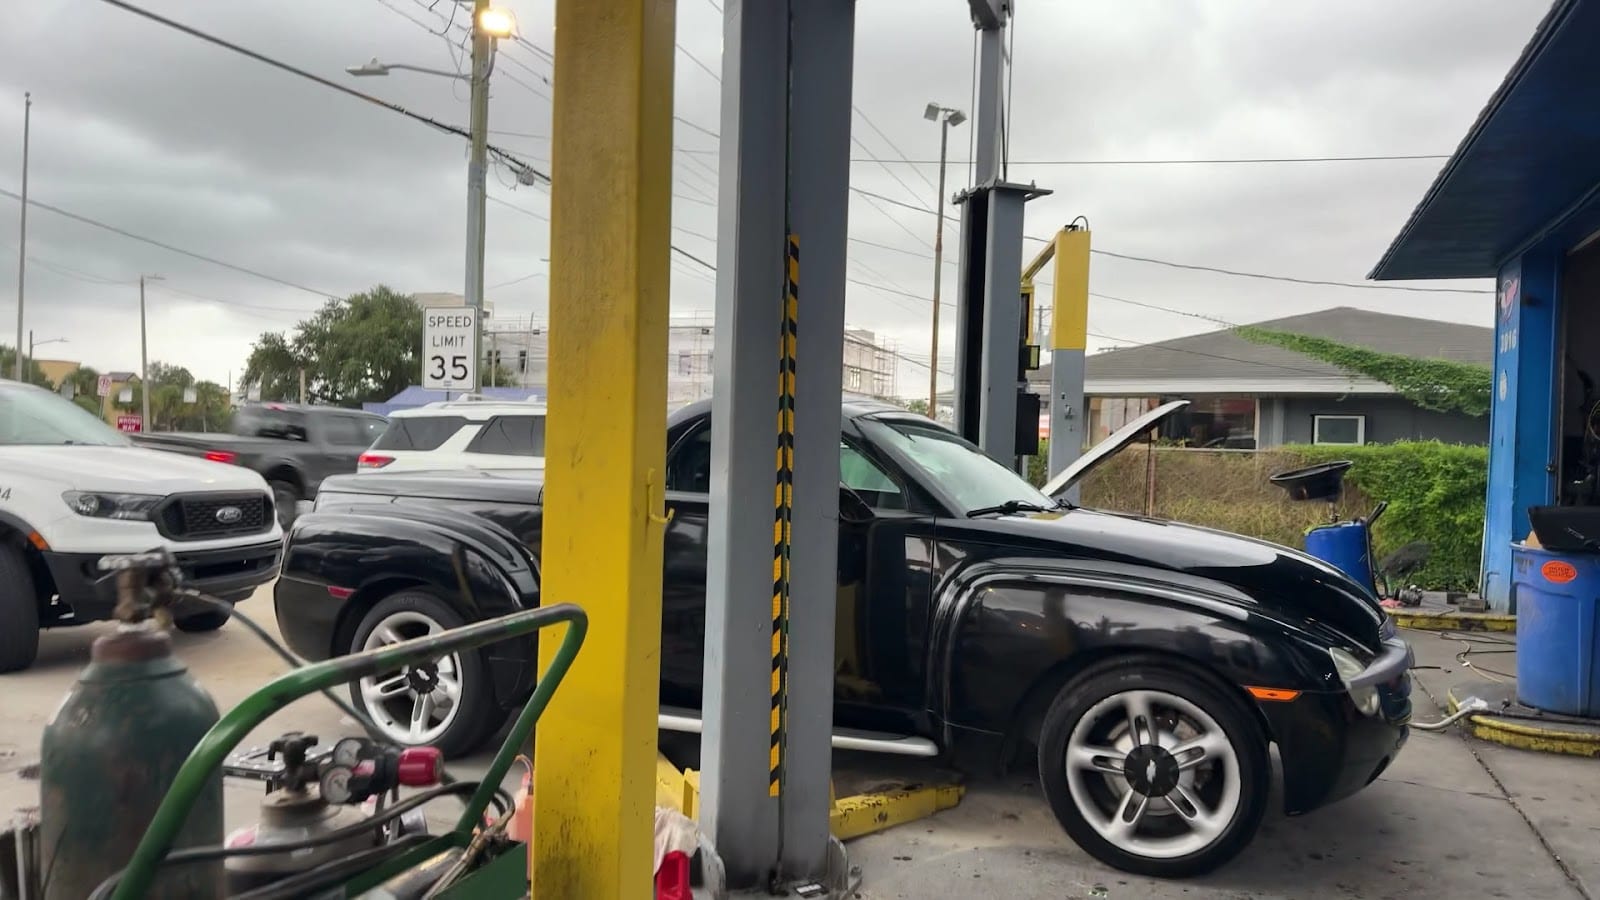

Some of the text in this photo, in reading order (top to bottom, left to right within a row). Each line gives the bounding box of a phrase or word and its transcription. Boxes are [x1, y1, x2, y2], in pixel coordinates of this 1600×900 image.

[428, 315, 472, 328] SPEED
[432, 335, 466, 348] LIMIT
[430, 355, 468, 381] 35
[118, 417, 140, 425] WRONG
[122, 424, 136, 432] WAY
[0, 487, 12, 501] 4
